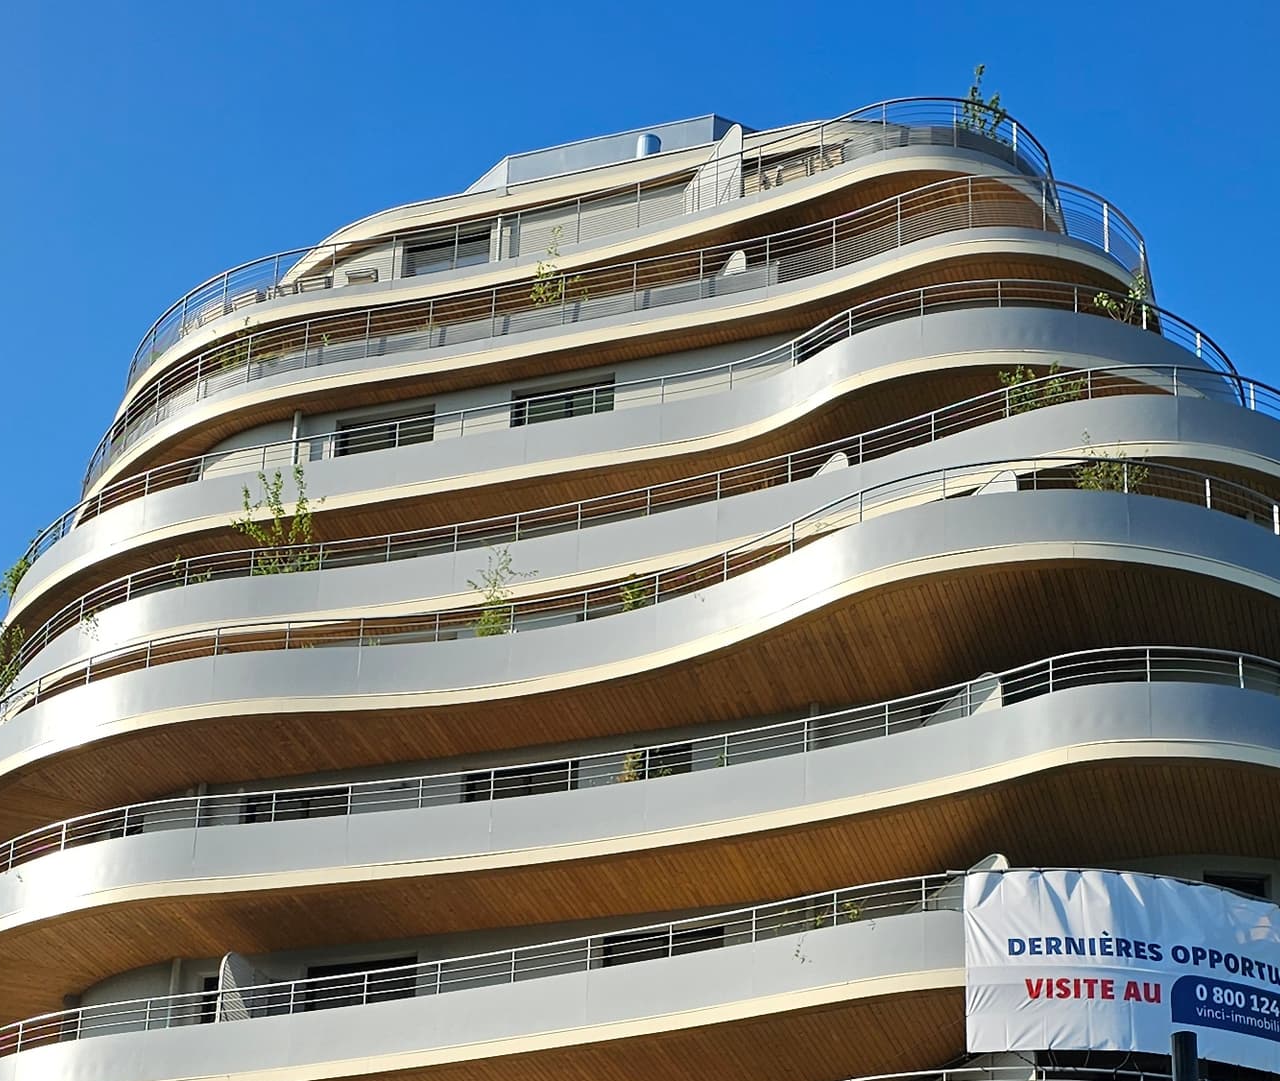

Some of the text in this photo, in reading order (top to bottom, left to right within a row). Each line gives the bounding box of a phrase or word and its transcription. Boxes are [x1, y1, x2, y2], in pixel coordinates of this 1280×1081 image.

[1007, 930, 1163, 962] DERNIÈRES
[1025, 978, 1161, 1004] VISITE AU
[1195, 984, 1208, 1001] 0
[1212, 985, 1246, 1009] 800
[1249, 994, 1280, 1018] 124
